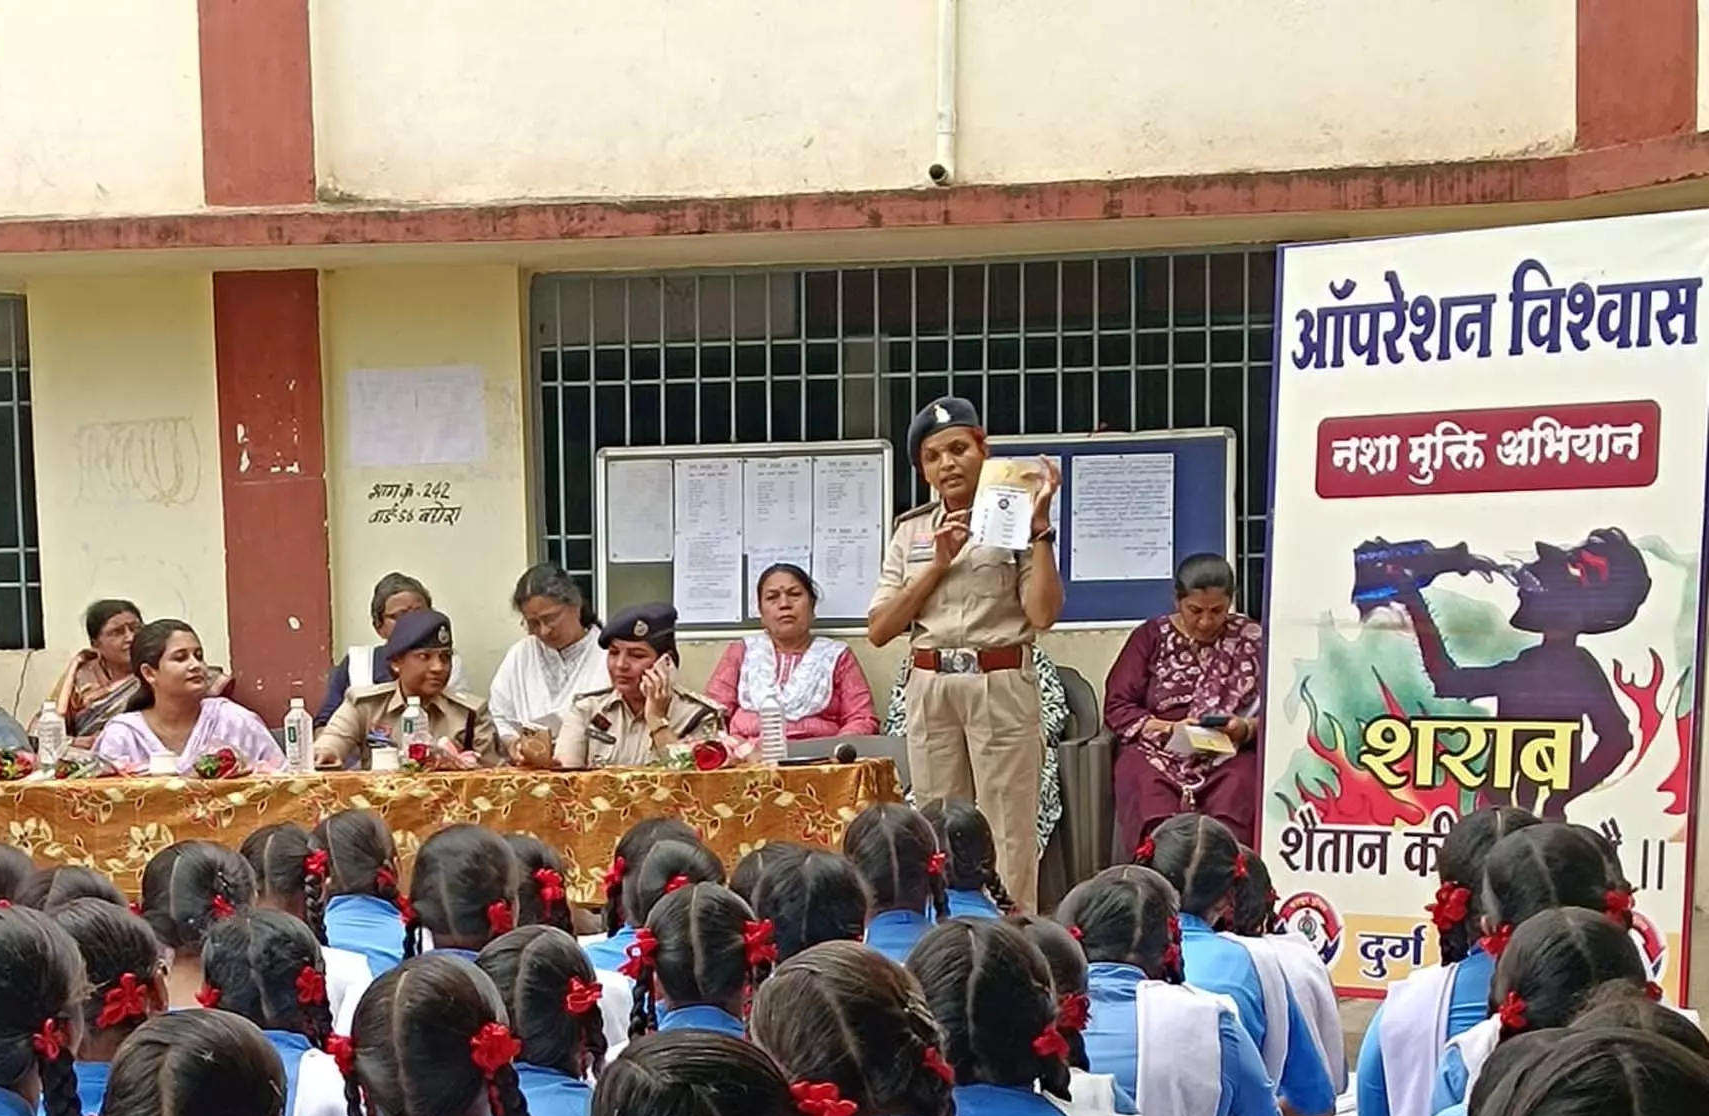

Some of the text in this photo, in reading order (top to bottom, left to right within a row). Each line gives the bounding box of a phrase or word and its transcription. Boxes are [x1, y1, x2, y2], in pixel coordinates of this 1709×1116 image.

[1292, 259, 1702, 369] ऑपरेशन विश्वास
[1331, 416, 1643, 484] नशा मुक्ति अभियान
[1359, 716, 1581, 790] शराब
[1278, 806, 1391, 875] शैतान
[1358, 925, 1427, 978] दुर्ग
